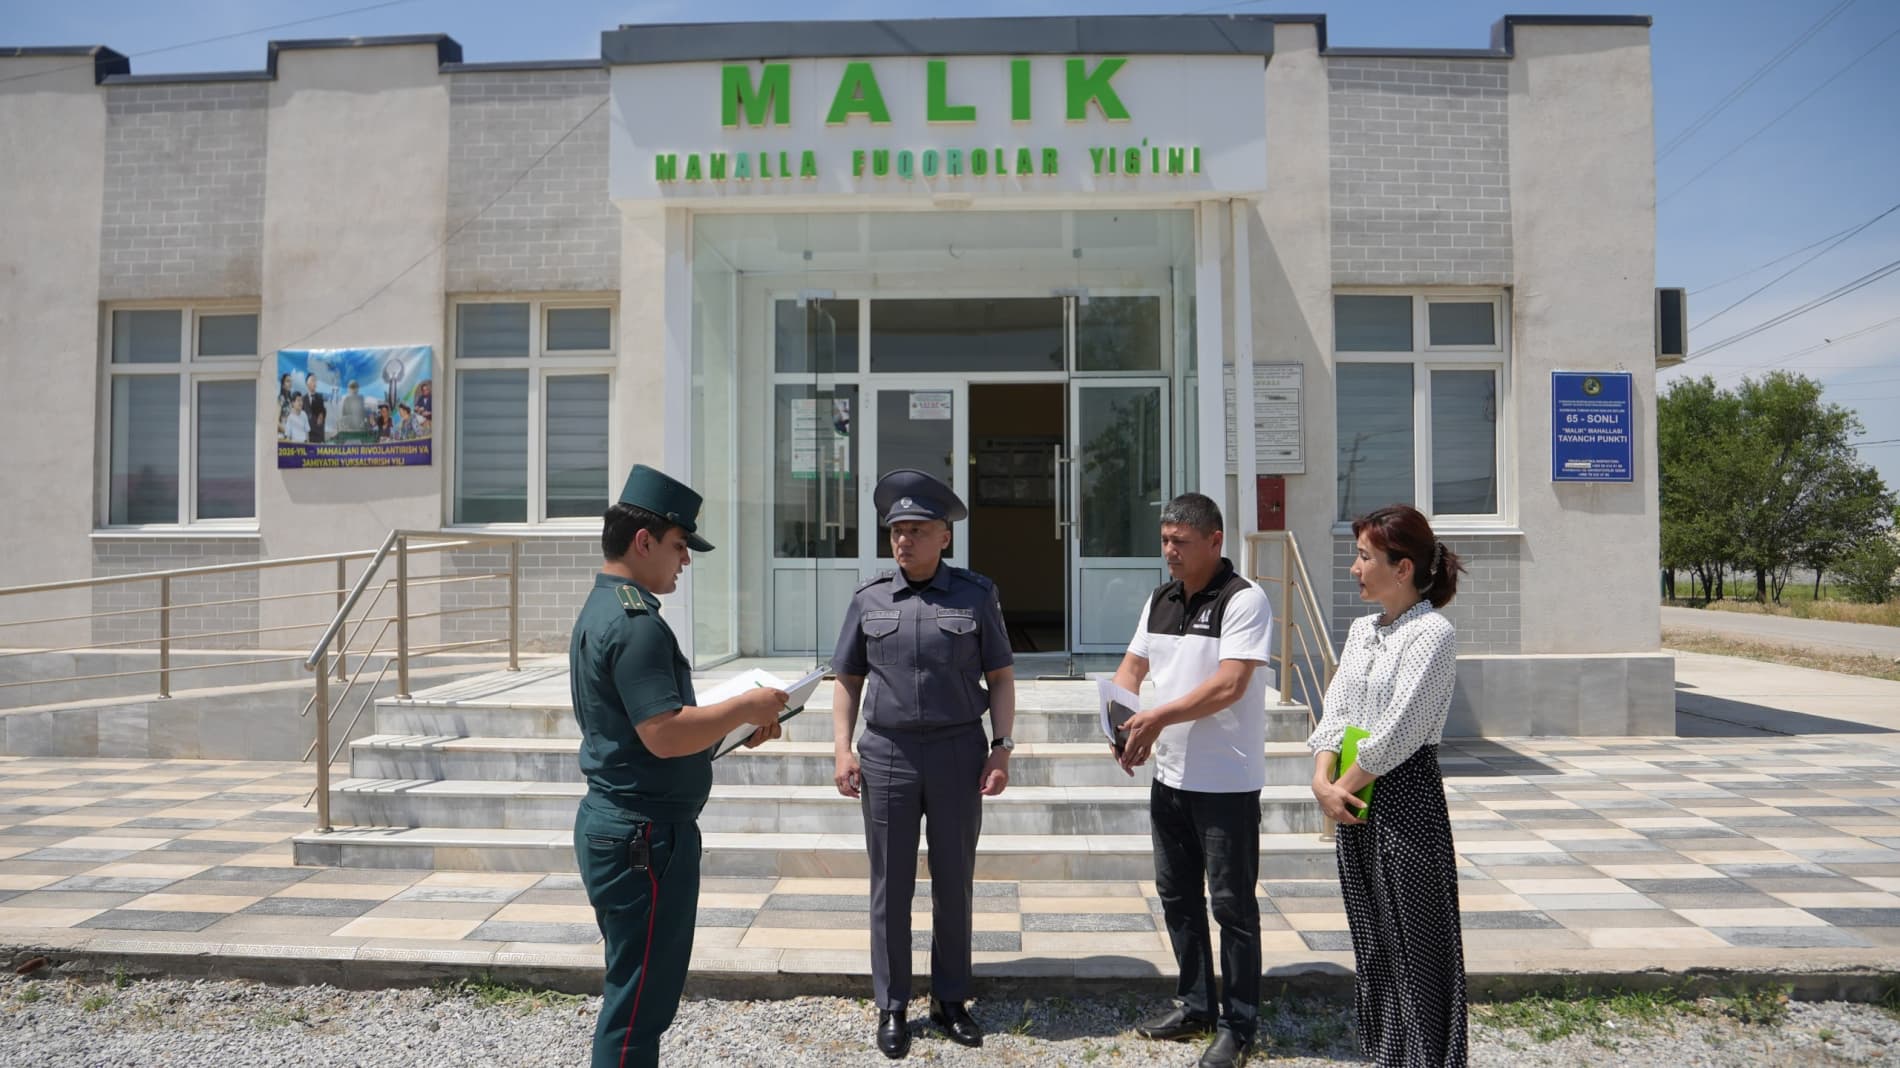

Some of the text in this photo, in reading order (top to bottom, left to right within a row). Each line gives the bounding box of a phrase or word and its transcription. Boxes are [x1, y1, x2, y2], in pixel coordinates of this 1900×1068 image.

[720, 57, 1132, 128] MALIK
[654, 149, 818, 183] MAHALLA
[851, 146, 1060, 181] FUQOROLAR
[1566, 414, 1578, 423] 65
[1587, 414, 1618, 424] SONLI
[1558, 435, 1628, 443] TAYANCH PUNKTI
